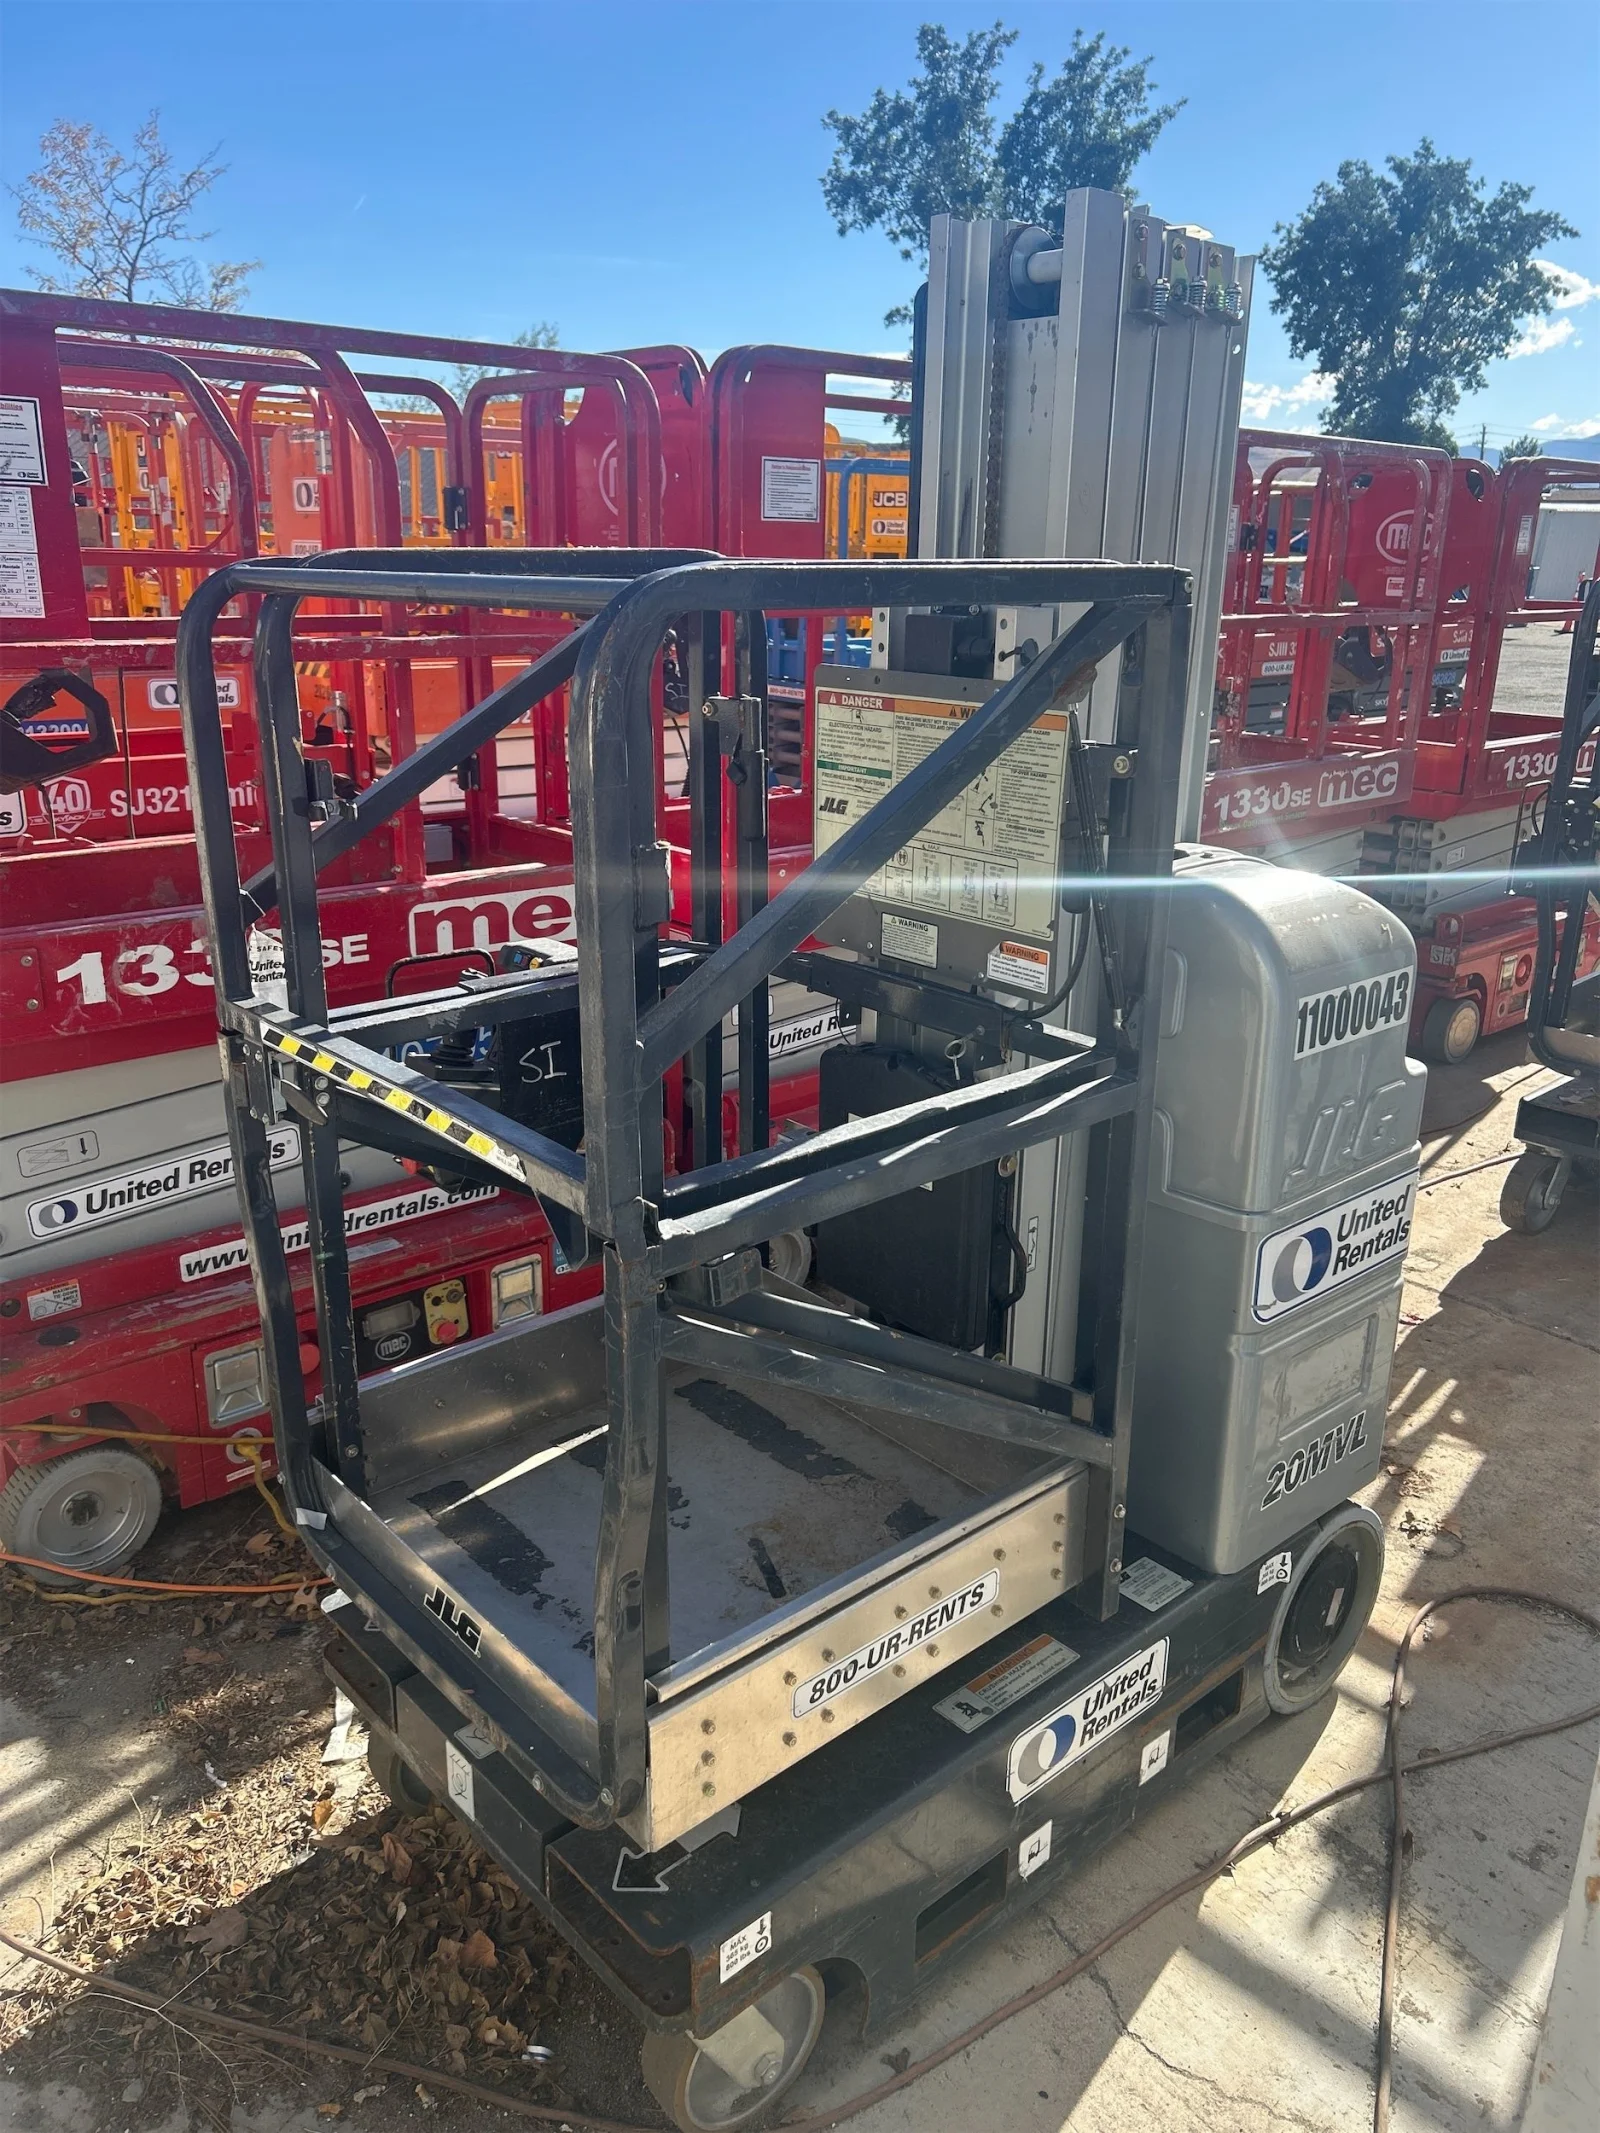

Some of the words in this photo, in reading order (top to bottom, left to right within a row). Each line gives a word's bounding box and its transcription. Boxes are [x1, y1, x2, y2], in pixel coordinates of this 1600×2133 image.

[874, 493, 907, 507] JCB
[1386, 523, 1433, 550] mc
[1264, 662, 1293, 672] 800-UR-RE
[769, 687, 804, 697] 800-UR-RENTS
[841, 694, 883, 710] DANGER
[828, 721, 863, 732] ELECTROCUTION
[915, 722, 937, 730] INSPECTED
[838, 765, 867, 774] IMPORTANT
[1504, 752, 1558, 781] 1330
[1320, 765, 1397, 804] mec
[110, 786, 192, 817] SJ321
[819, 797, 849, 815] JLG
[414, 895, 572, 956] me
[898, 917, 928, 932] WARNING
[250, 959, 285, 971] Unite
[1005, 945, 1039, 961] WARNING
[250, 970, 286, 982] Renta
[1297, 971, 1409, 1054] 11000043
[769, 1015, 823, 1049] United
[1282, 1079, 1406, 1194] JLG
[86, 1168, 180, 1215] United
[189, 1140, 285, 1184] Renls
[1337, 1184, 1410, 1242] United
[1332, 1216, 1410, 1277] Rentals
[380, 1334, 407, 1357] mec
[1260, 1410, 1368, 1511] 20MVL
[423, 1585, 484, 1656] JLG
[809, 1582, 985, 1704] 800-UR-RENTS
[993, 1647, 1034, 1677] WARNING
[978, 1675, 1009, 1696] CRUSHING
[1009, 1659, 1032, 1677] HAZARD
[1083, 1652, 1155, 1721] United
[1079, 1679, 1158, 1748] Rentals
